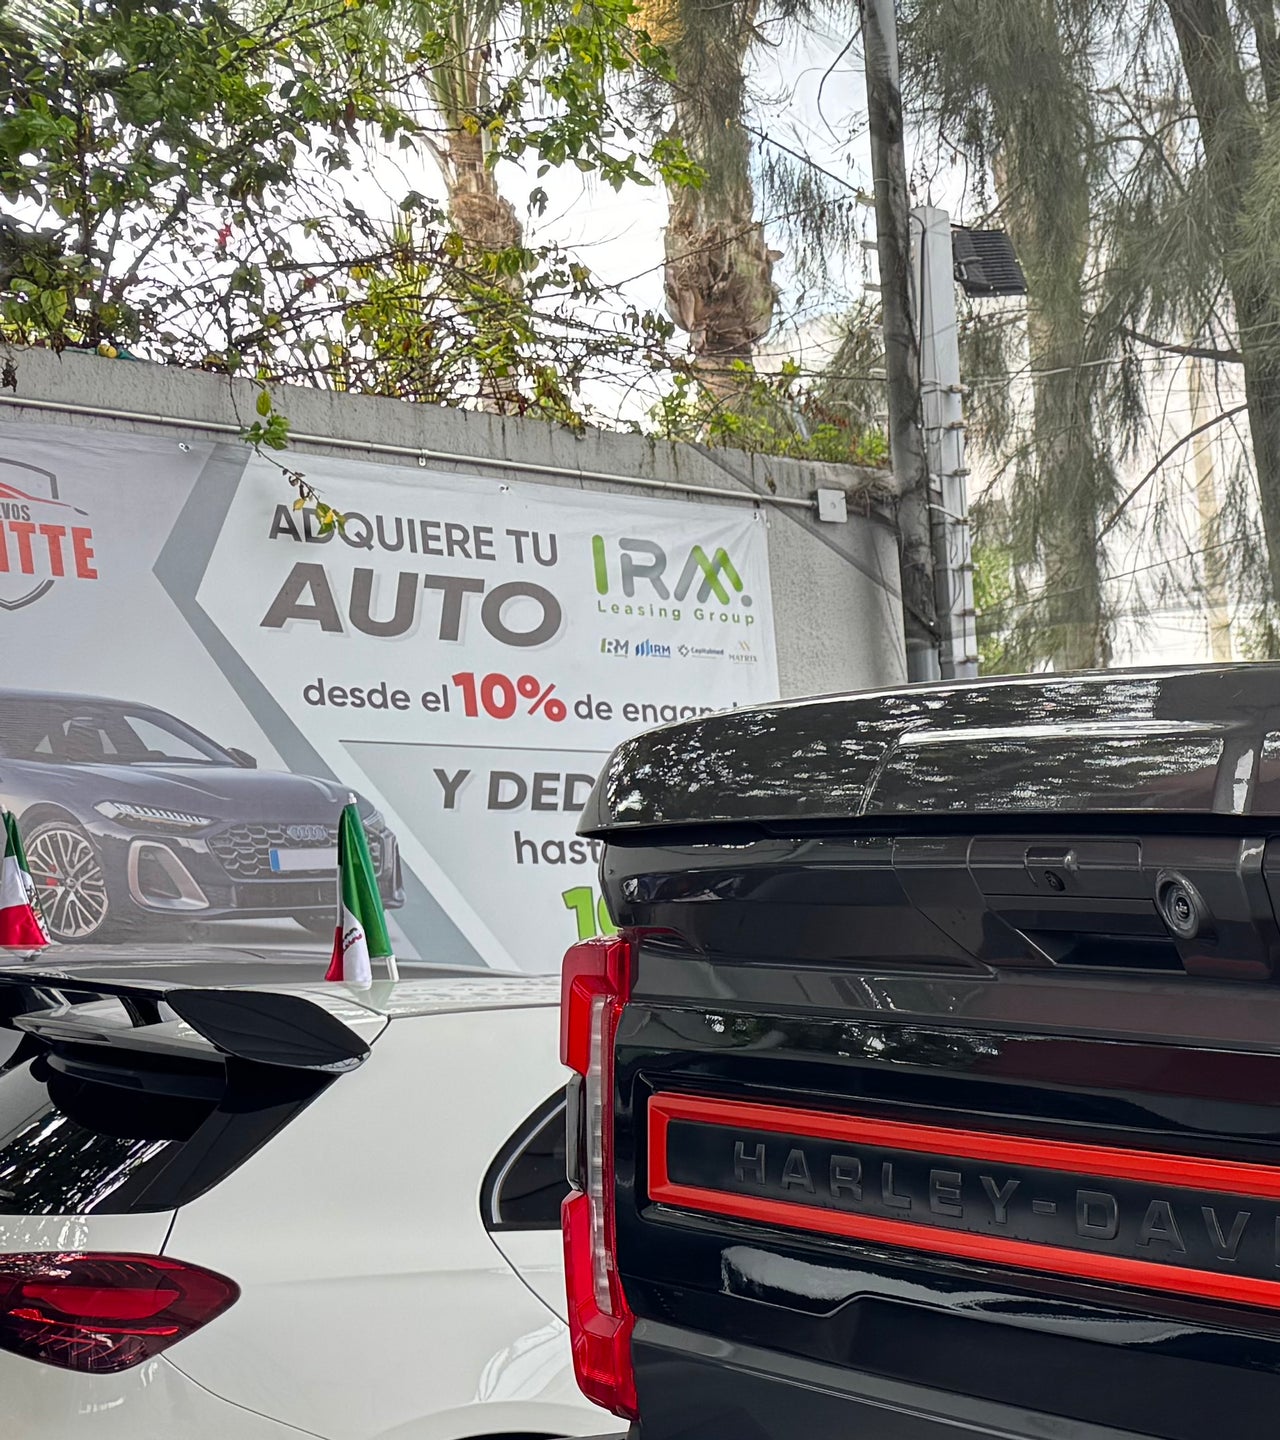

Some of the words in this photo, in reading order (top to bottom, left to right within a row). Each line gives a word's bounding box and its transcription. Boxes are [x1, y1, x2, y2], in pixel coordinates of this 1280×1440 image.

[0, 502, 31, 522] VOS
[268, 504, 496, 561] ADQUIERE
[505, 528, 558, 567] TU
[259, 561, 562, 647] AUTO
[598, 600, 681, 621] Leasing
[694, 608, 755, 627] Group
[303, 678, 410, 711] desde
[421, 684, 450, 713] el
[452, 672, 567, 722] 10%
[574, 694, 613, 721] de
[433, 768, 471, 809] Y
